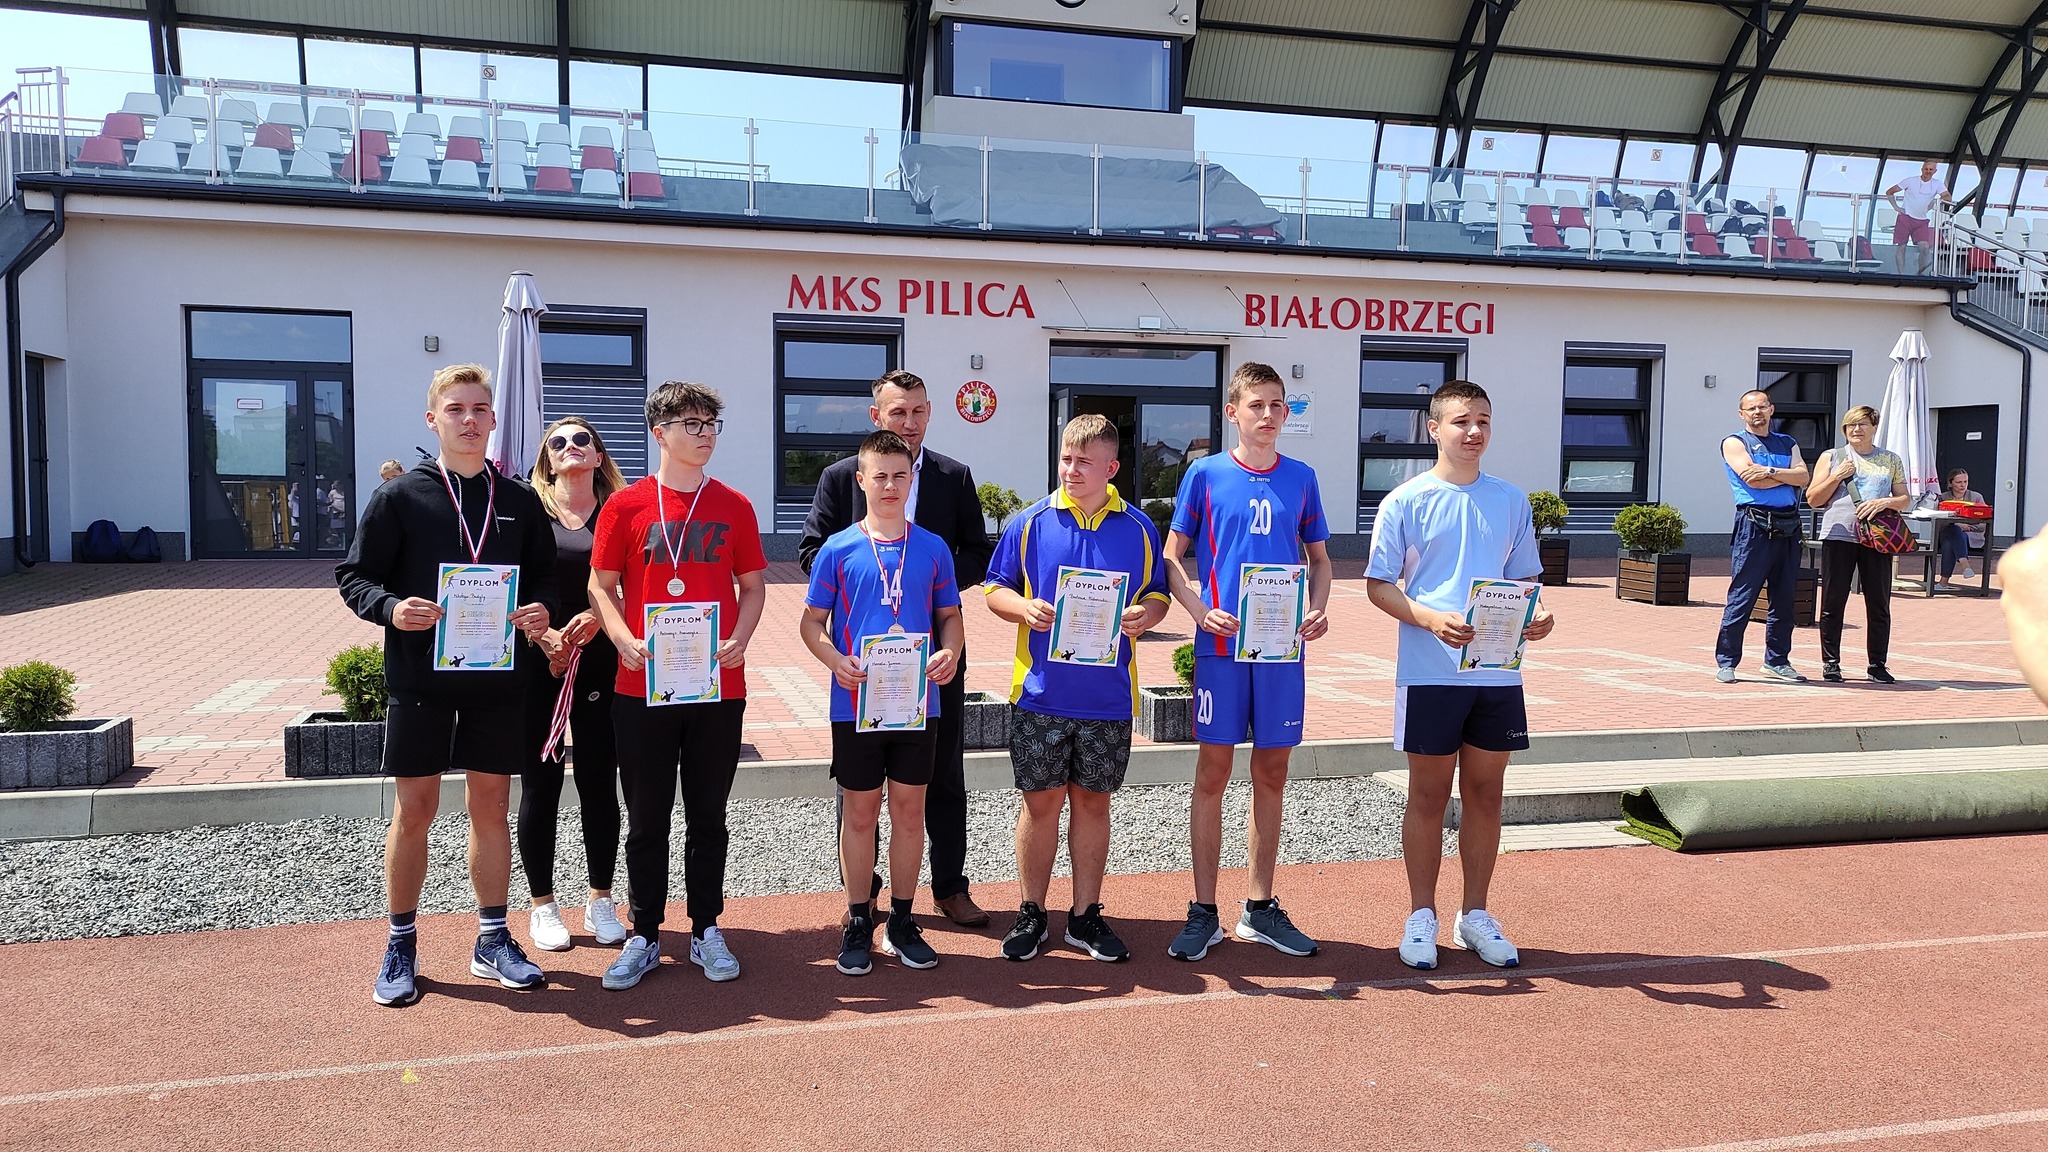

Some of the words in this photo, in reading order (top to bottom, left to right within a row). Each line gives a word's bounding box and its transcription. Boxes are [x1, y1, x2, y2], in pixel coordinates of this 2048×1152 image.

[788, 274, 881, 312] MKS
[899, 278, 1035, 318] PILICA
[1245, 293, 1494, 335] BIAŁOBRZEGI
[961, 382, 991, 394] PILICA
[1249, 498, 1272, 536] 20
[644, 520, 731, 566] NIKE
[460, 579, 499, 587] DYPLOM
[880, 569, 903, 606] 14
[1075, 582, 1110, 591] DYPLOM
[1257, 578, 1291, 586] DYPLOM
[1486, 592, 1522, 600] DYPLOM
[877, 647, 912, 655] DYPLOM
[1197, 688, 1213, 725] 20
